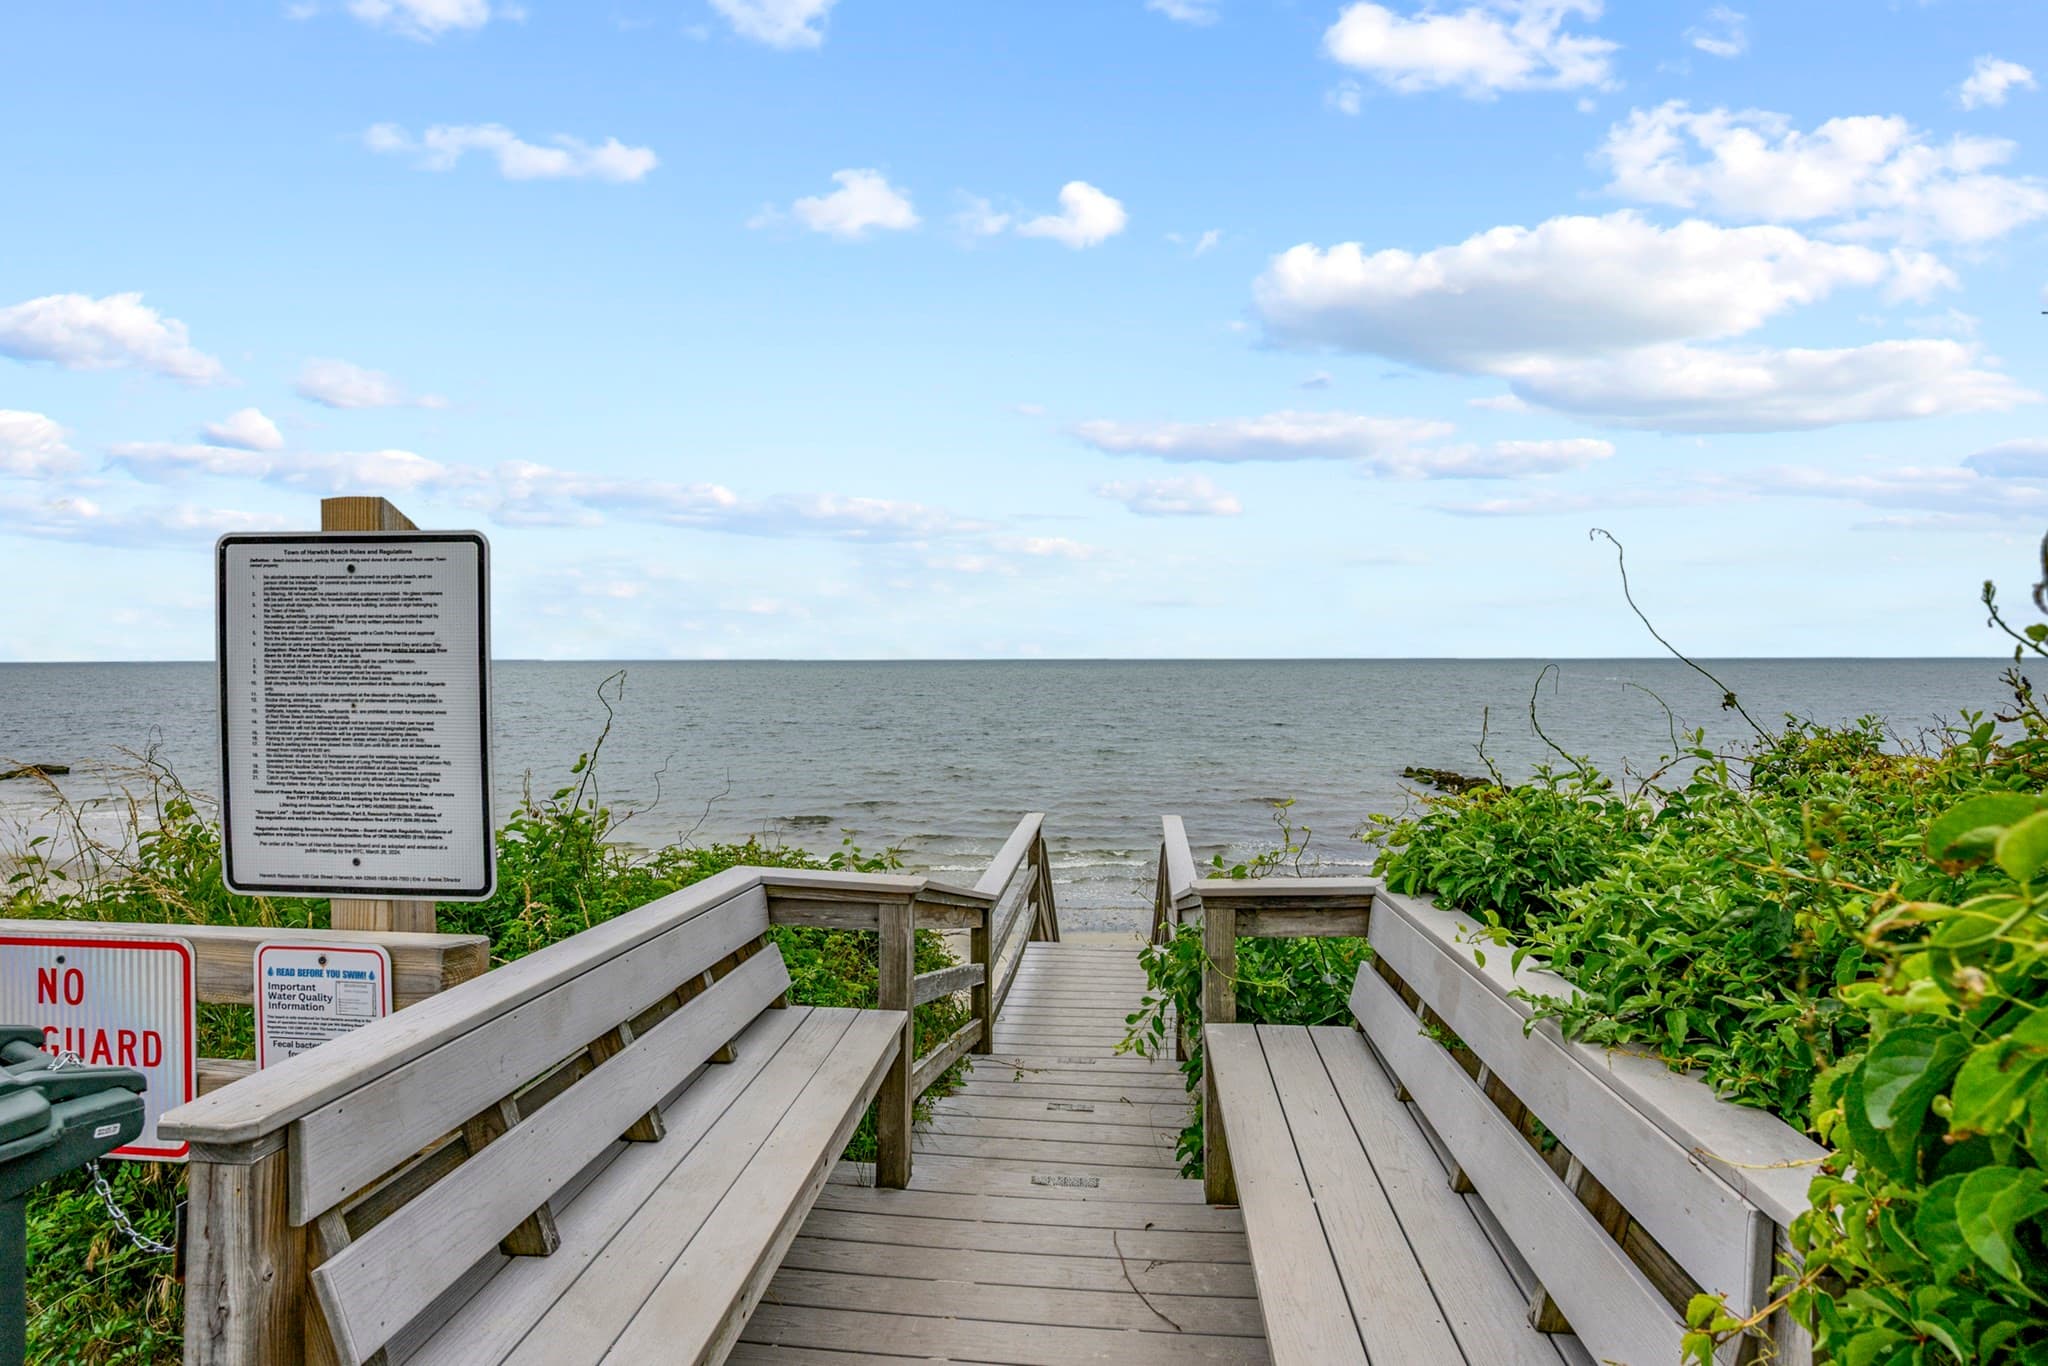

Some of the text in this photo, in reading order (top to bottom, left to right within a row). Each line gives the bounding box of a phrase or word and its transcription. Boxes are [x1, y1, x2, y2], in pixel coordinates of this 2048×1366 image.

[276, 968, 366, 980] READ BEFORE YOU SWIM!
[38, 968, 84, 1005] NO
[268, 982, 316, 992] Important
[268, 992, 333, 1004] Water Quality
[268, 1002, 325, 1011] Information
[273, 1040, 294, 1048] Fecal
